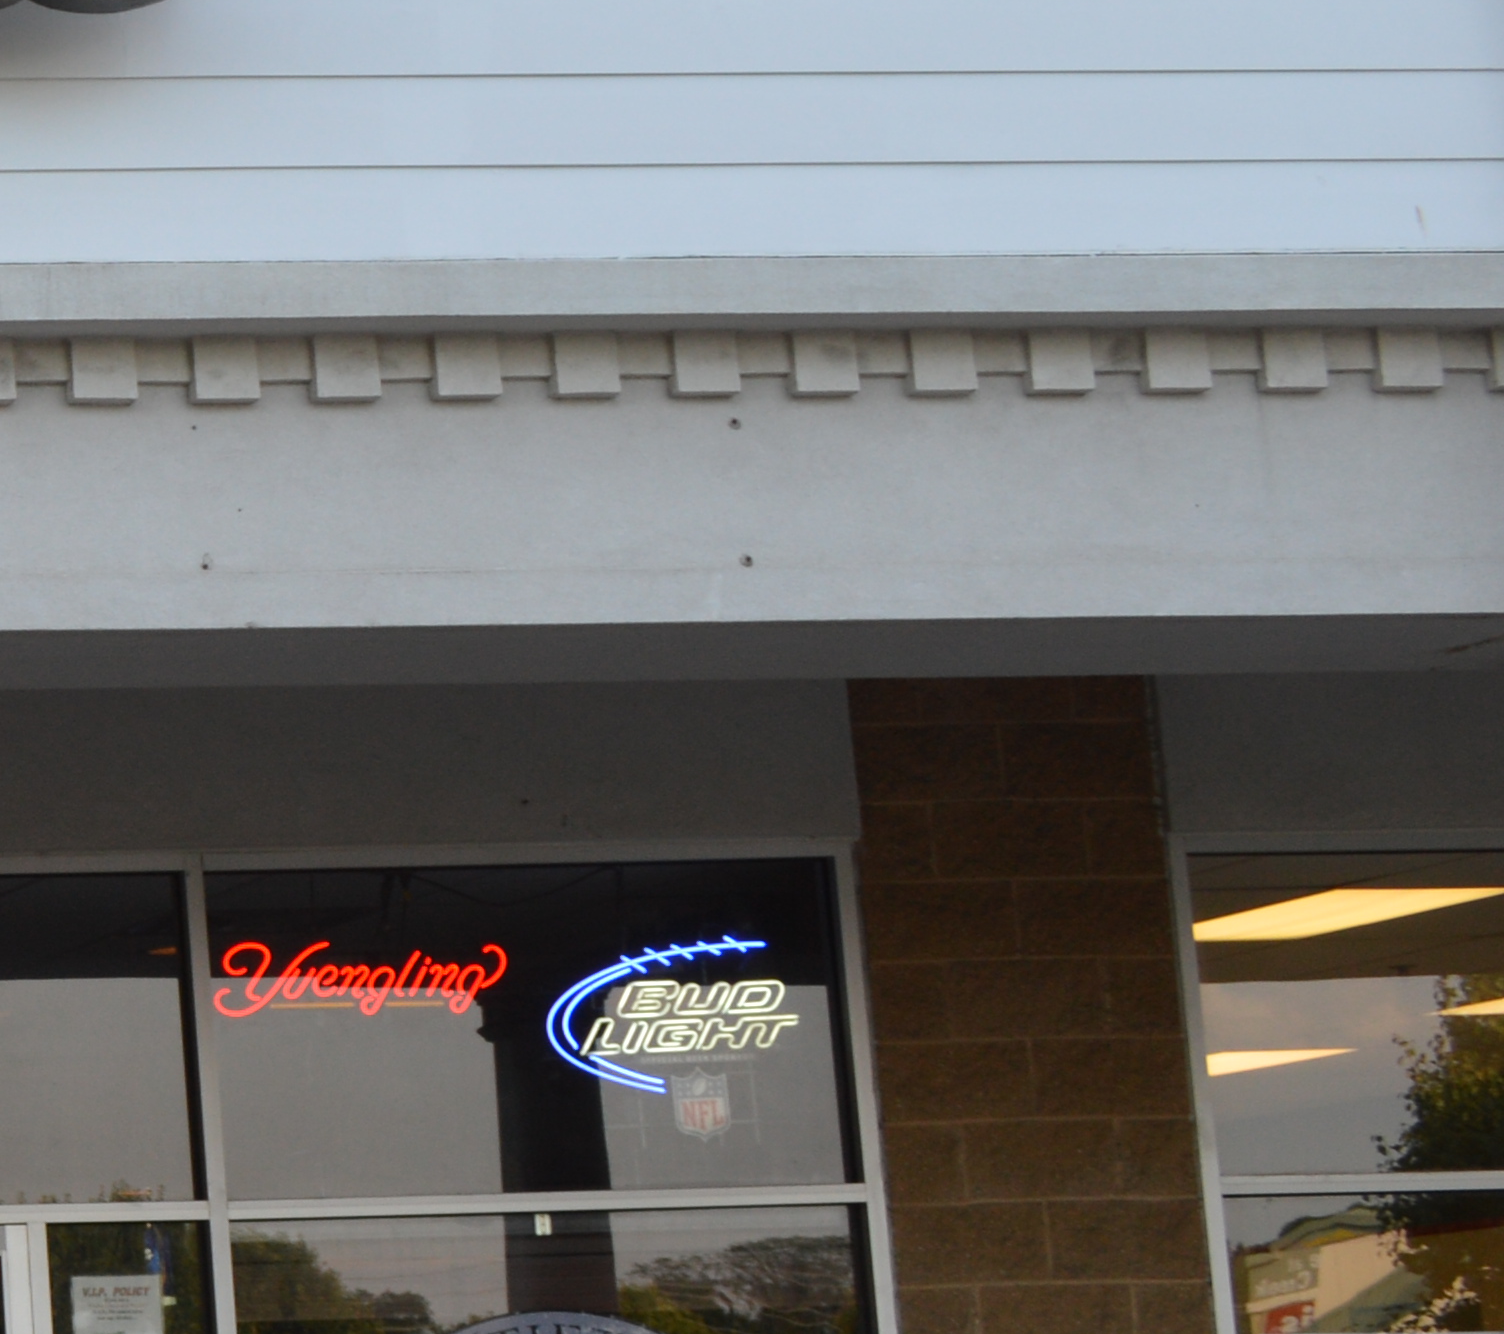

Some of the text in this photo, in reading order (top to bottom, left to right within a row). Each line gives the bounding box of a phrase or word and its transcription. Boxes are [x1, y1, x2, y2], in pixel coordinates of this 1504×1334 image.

[213, 941, 507, 1018] Yuengling
[617, 979, 785, 1018] BUD
[579, 1014, 799, 1057] LIGHT
[681, 1099, 727, 1133] NFL
[113, 1287, 150, 1297] POLICY
